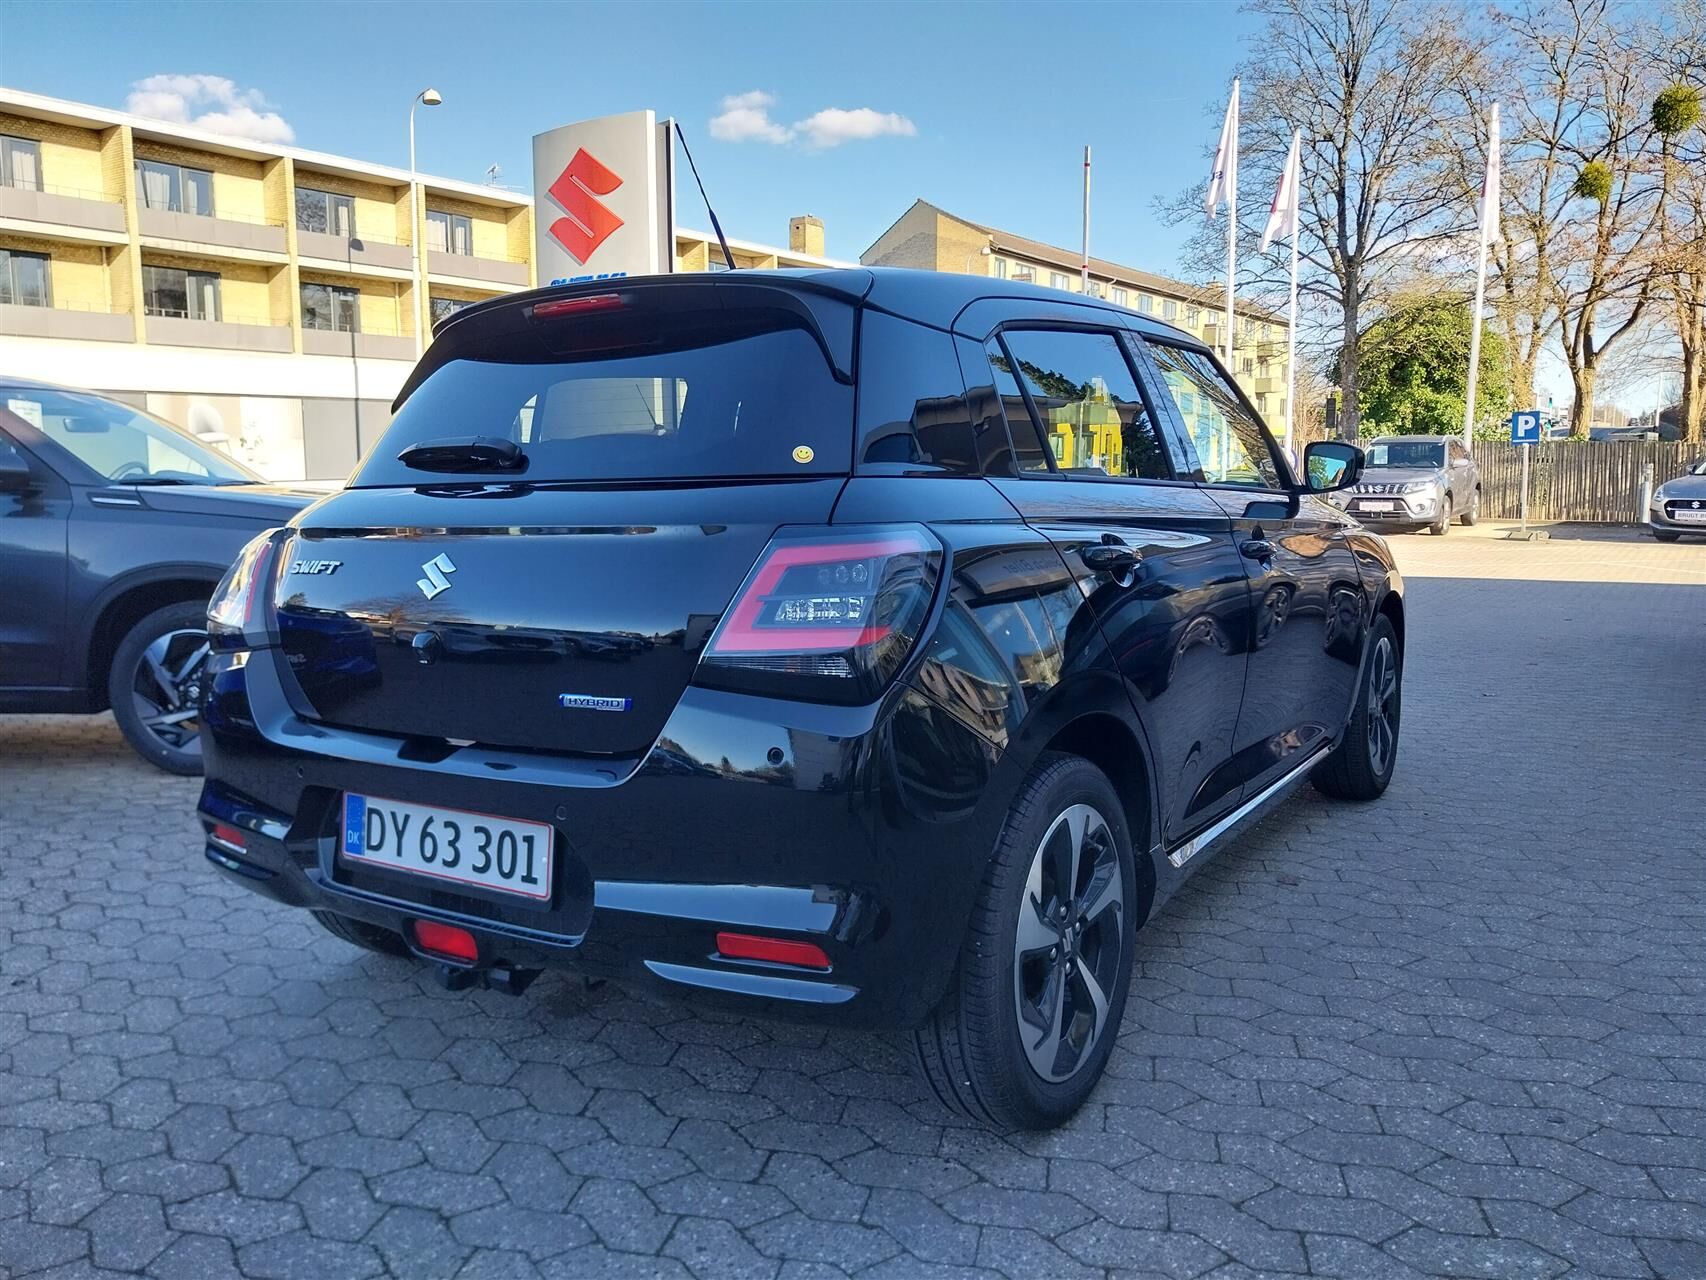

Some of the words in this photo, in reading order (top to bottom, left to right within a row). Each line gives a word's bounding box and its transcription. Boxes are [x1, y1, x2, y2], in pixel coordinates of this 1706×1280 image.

[1517, 415, 1536, 437] P
[289, 560, 344, 575] SWIFT
[568, 698, 621, 708] HYBRID
[347, 830, 360, 845] DK
[366, 806, 411, 858] DY
[419, 815, 461, 868] 63
[472, 825, 539, 885] 301
